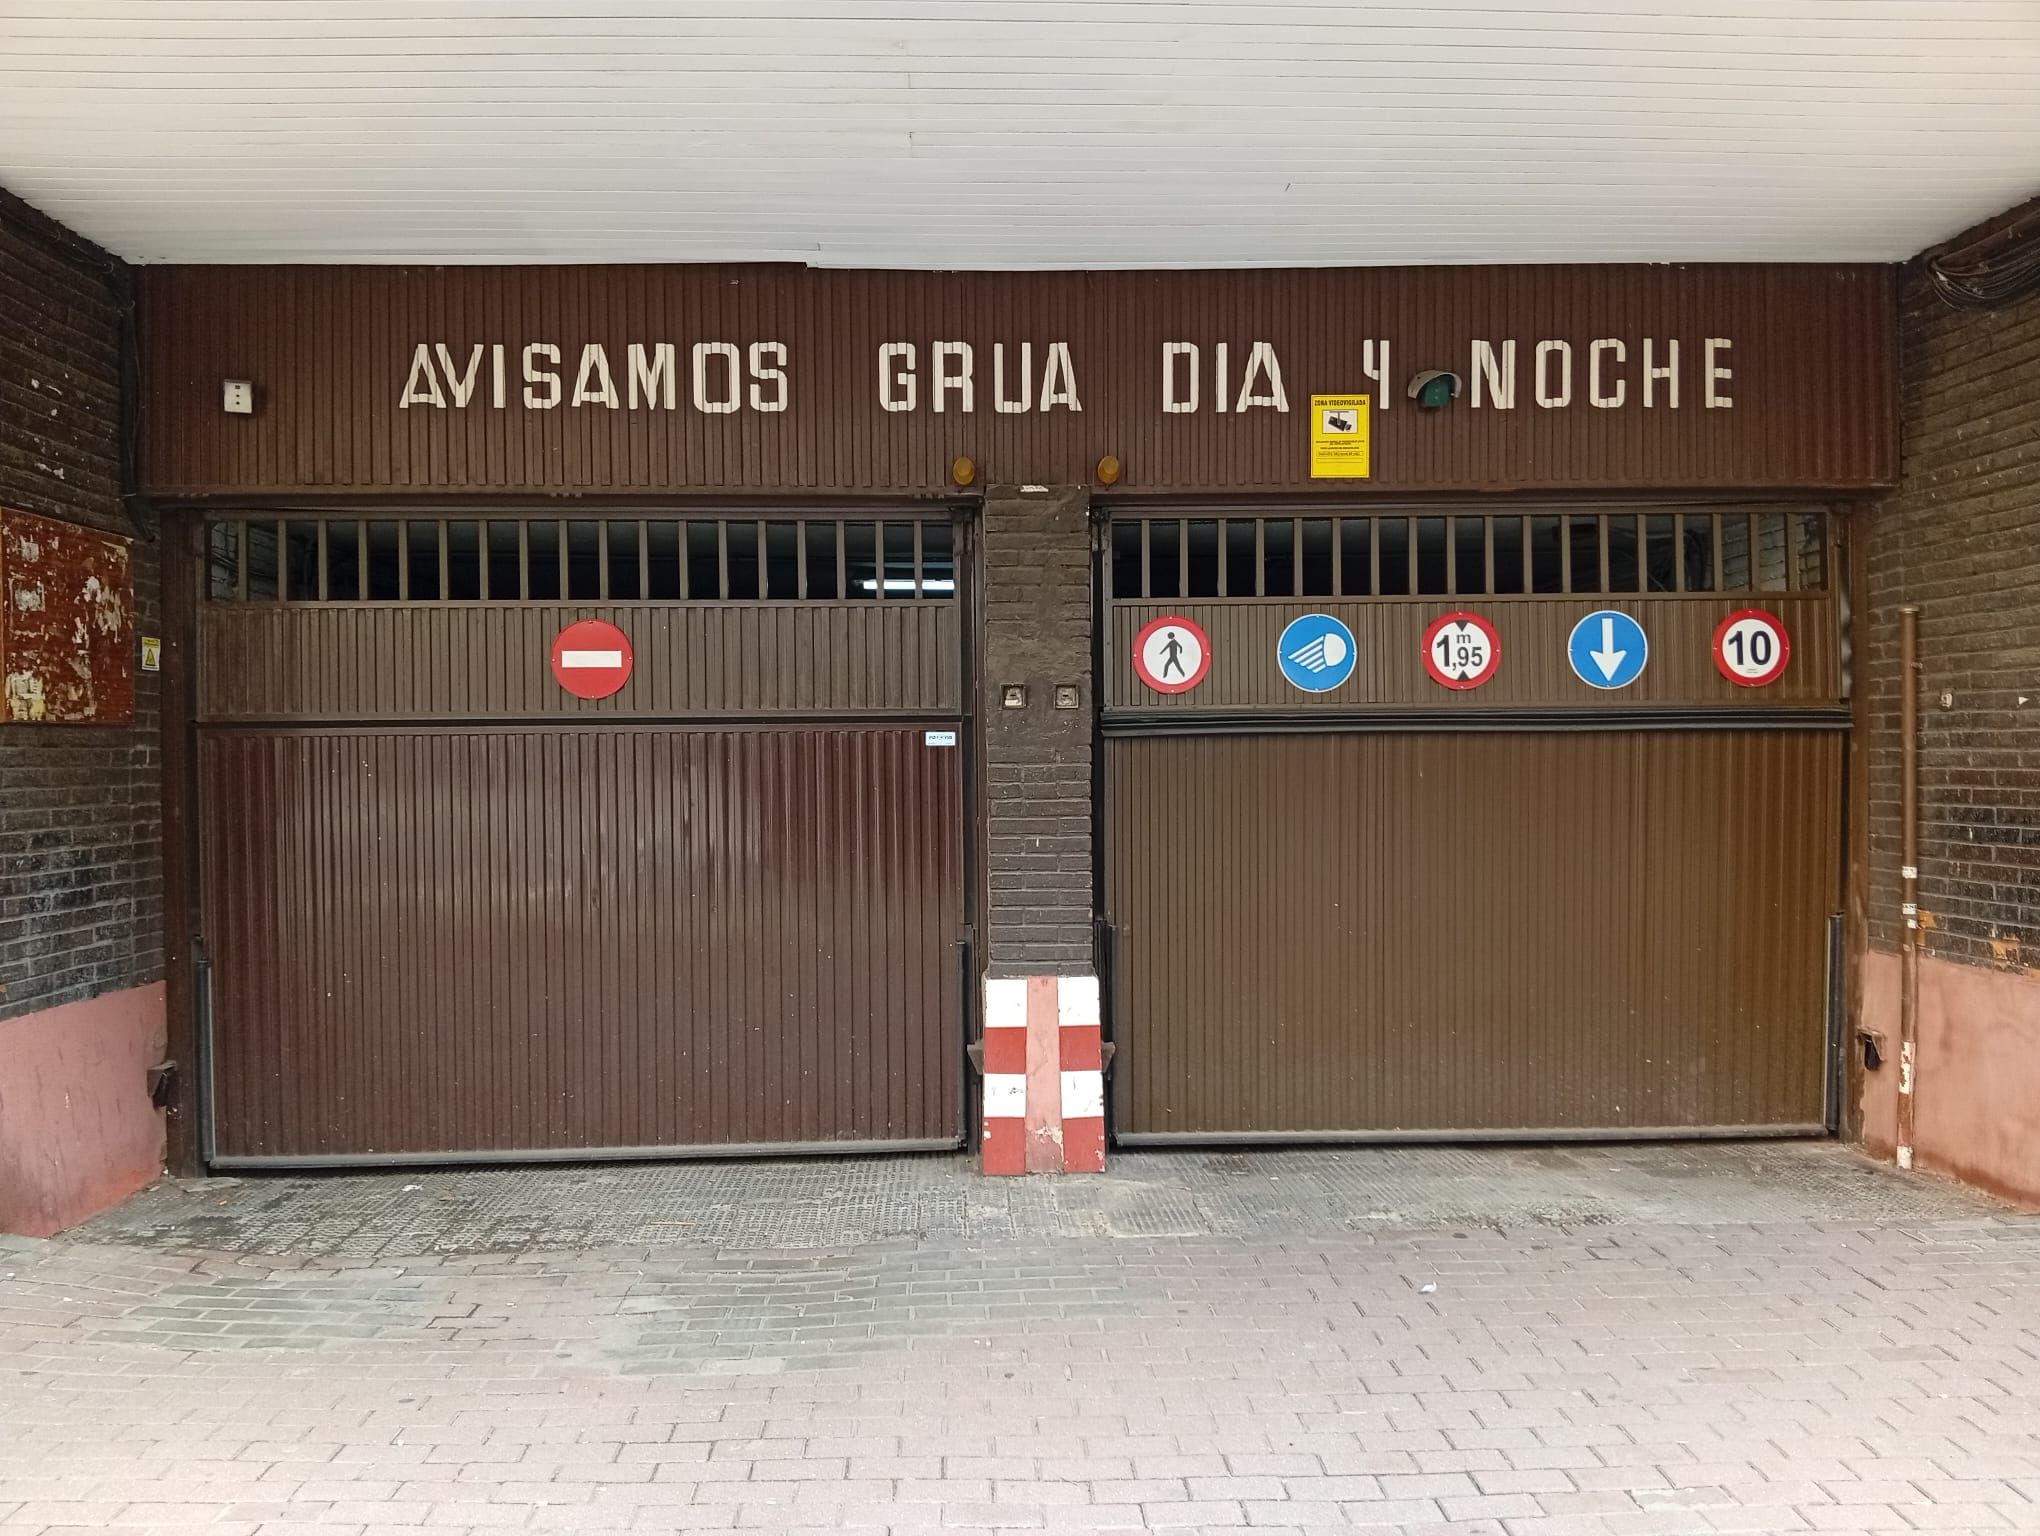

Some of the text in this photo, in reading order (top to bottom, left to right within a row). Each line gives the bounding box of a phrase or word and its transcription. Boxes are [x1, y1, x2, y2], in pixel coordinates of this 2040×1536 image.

[399, 341, 789, 414] AVISAMOS
[878, 340, 1083, 414] GRUA
[1162, 341, 1290, 414] DIA
[1470, 337, 1733, 409] NOCHE
[1436, 634, 1483, 671] 1,95
[1456, 634, 1471, 644] m
[1728, 630, 1772, 665] 10
